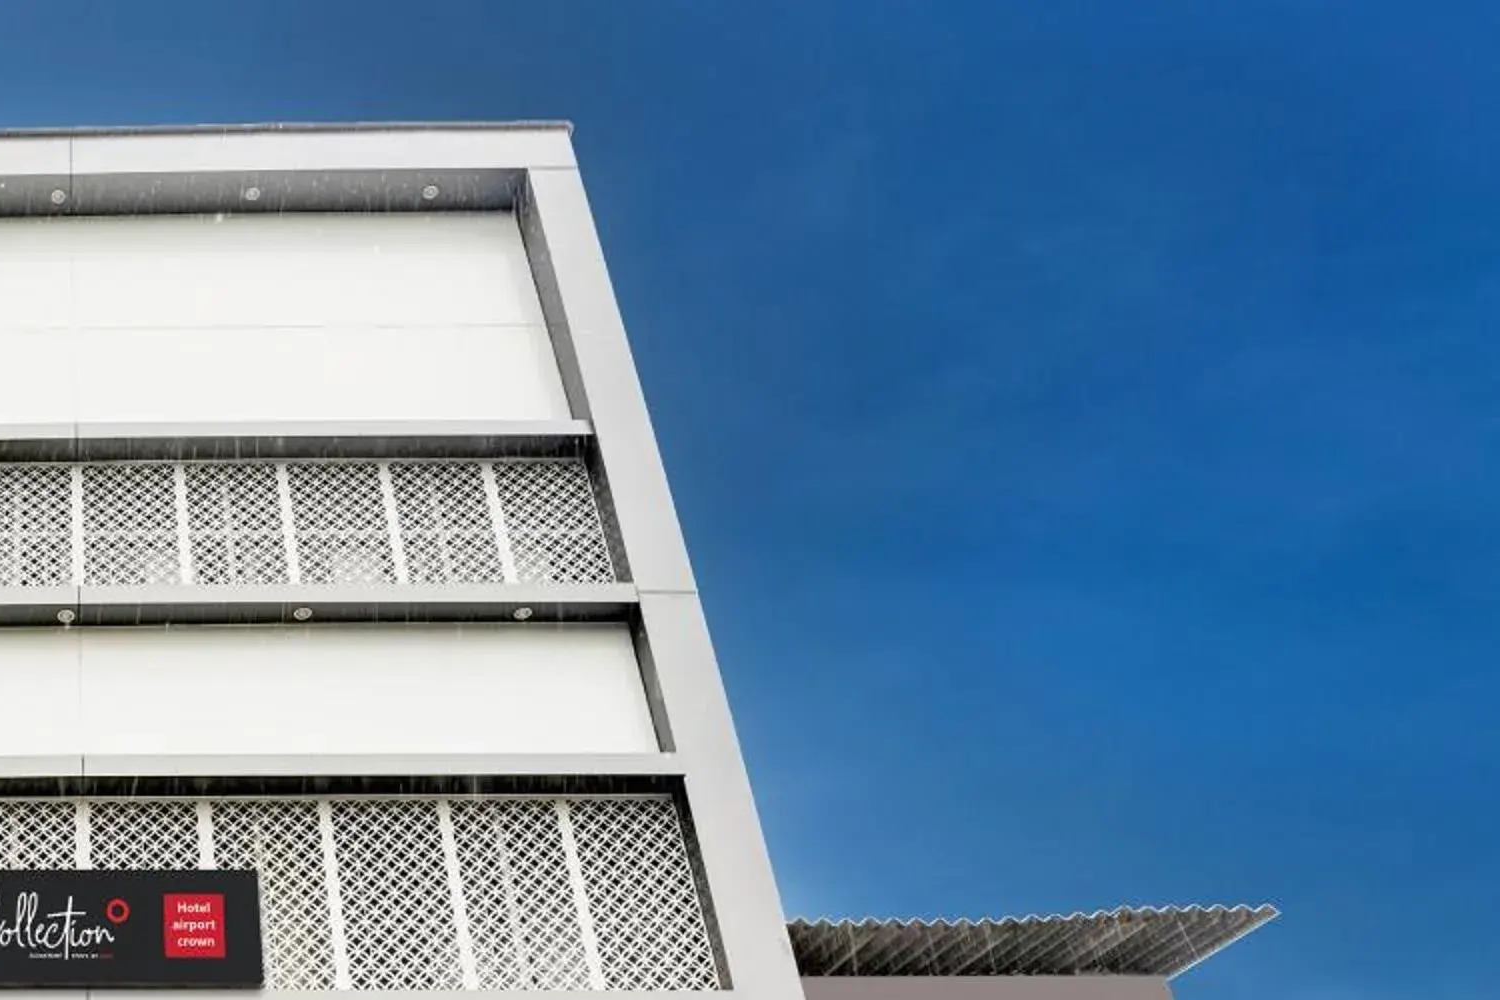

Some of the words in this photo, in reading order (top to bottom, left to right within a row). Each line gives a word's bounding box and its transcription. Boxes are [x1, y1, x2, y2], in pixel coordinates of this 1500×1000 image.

[177, 902, 211, 913] Hotel
[172, 918, 215, 932] airport
[177, 937, 215, 947] crown
